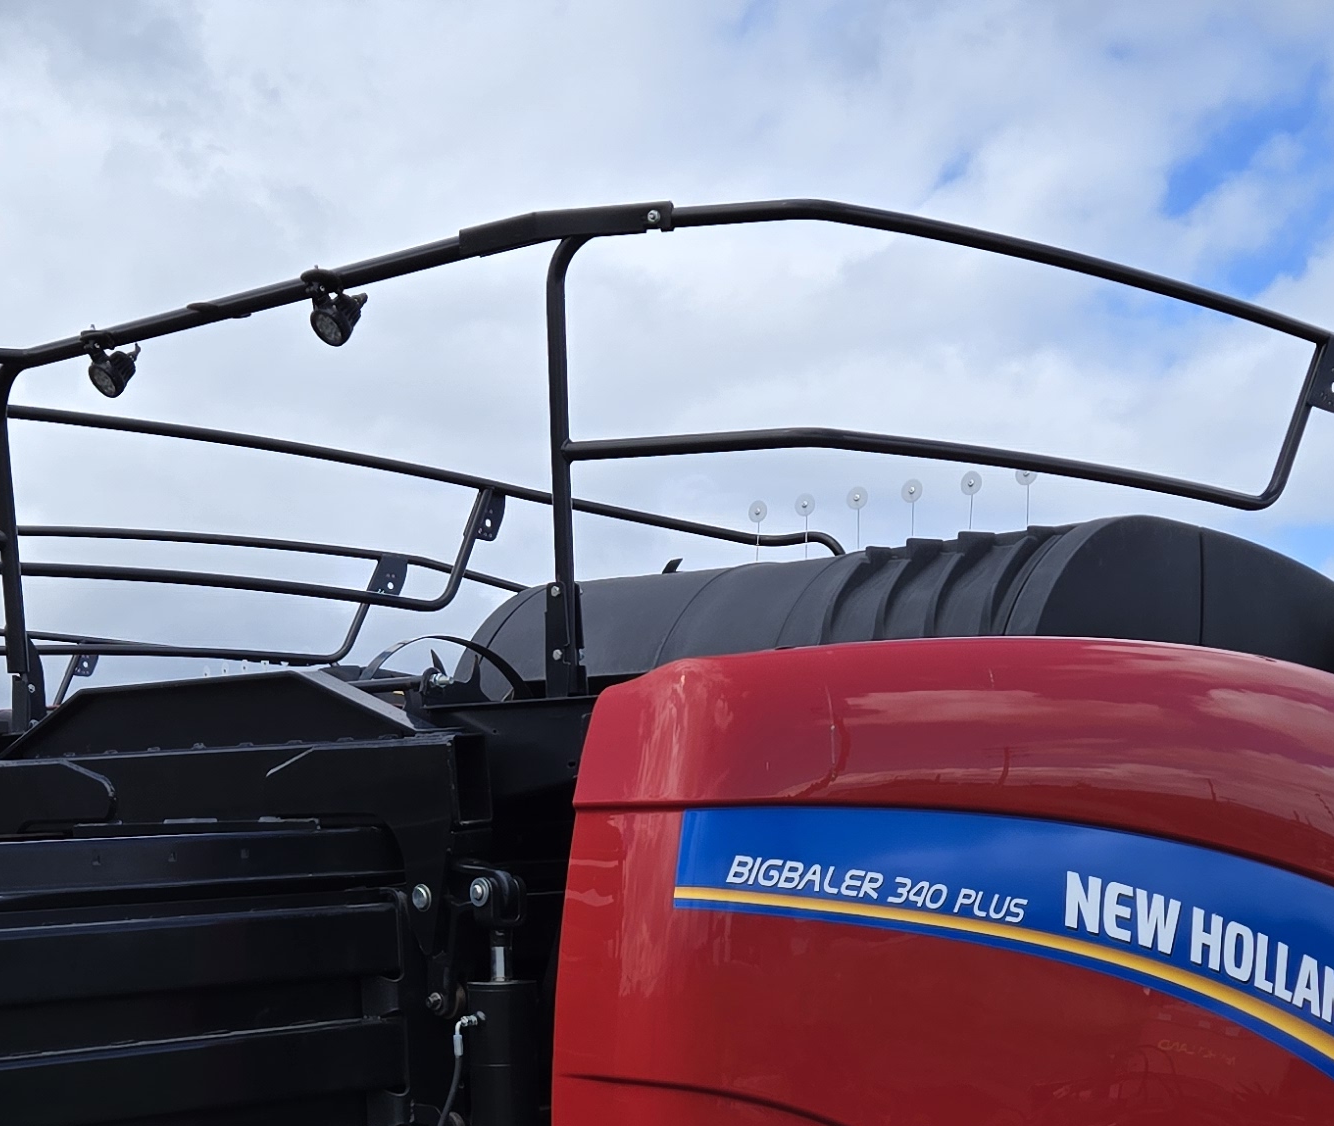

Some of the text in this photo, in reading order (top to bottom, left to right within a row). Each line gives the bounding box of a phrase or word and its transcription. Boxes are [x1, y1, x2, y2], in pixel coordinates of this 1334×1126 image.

[726, 855, 1029, 923] BIGBALER 340 PLUS
[1064, 870, 1182, 955] NEW
